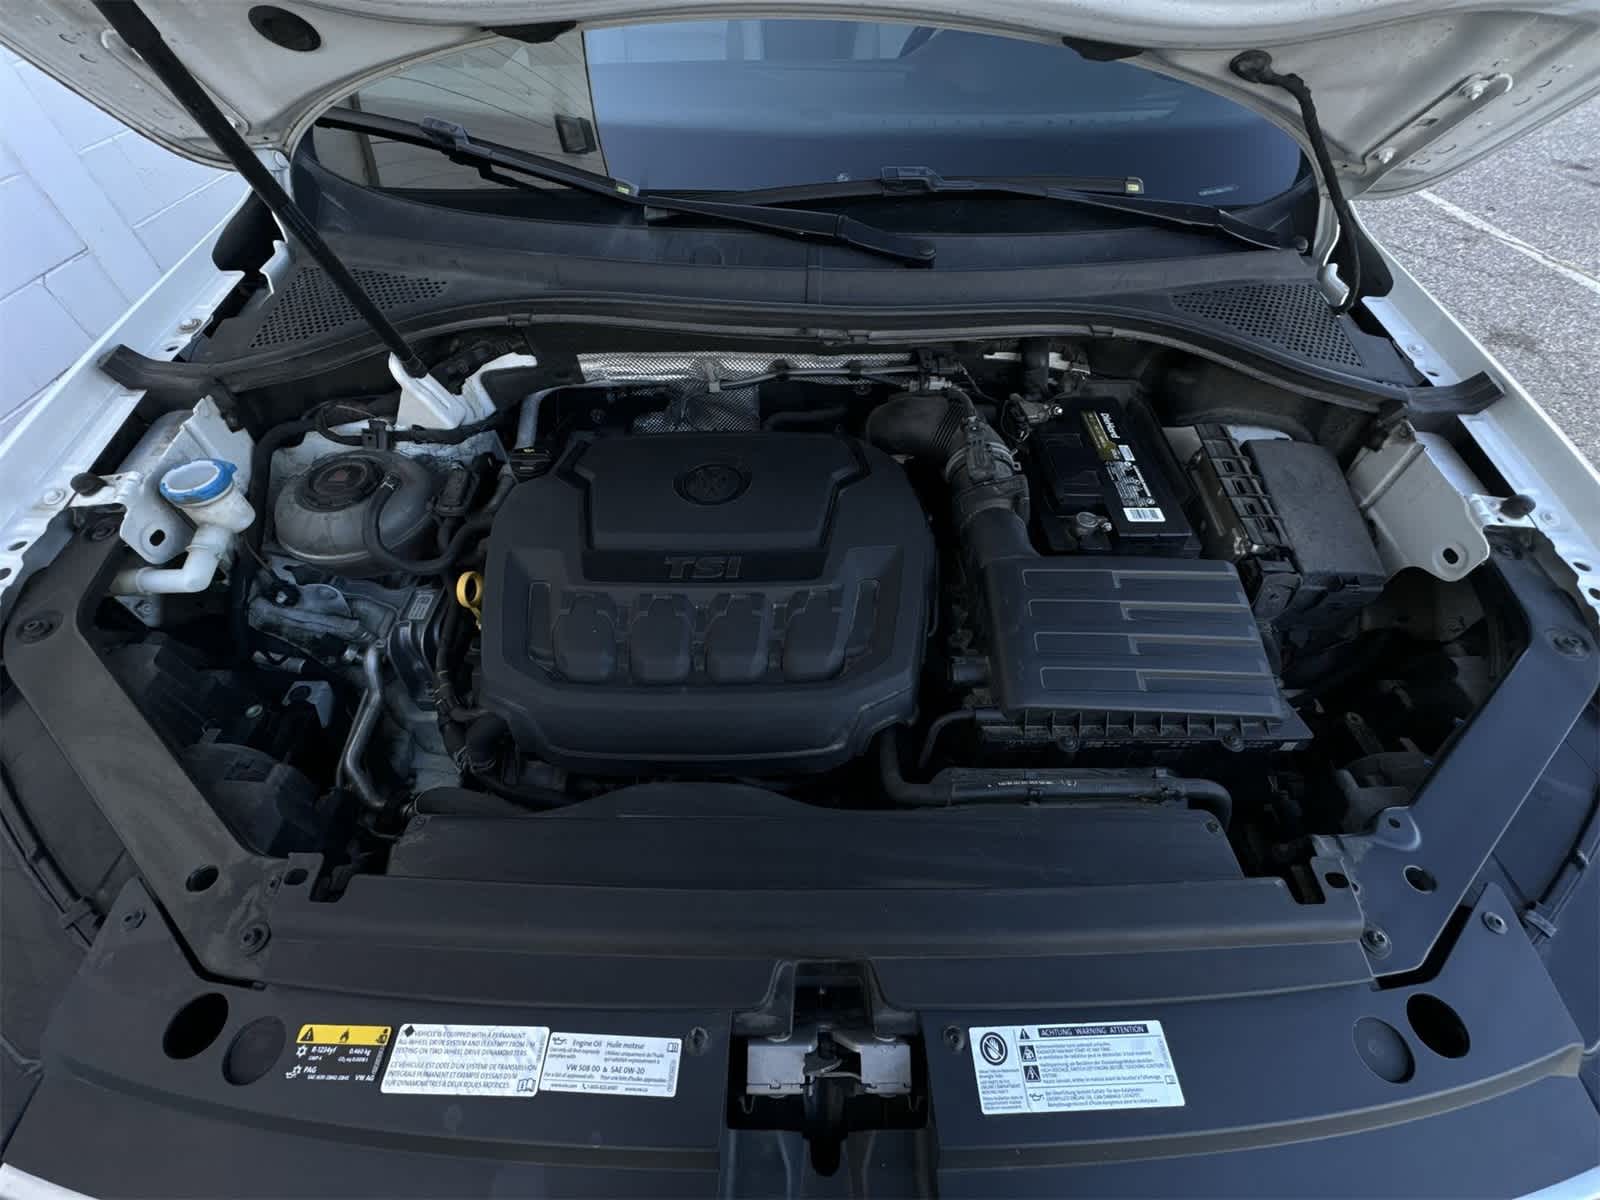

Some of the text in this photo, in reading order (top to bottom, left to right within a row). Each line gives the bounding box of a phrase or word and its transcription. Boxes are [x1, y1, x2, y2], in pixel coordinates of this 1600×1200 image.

[664, 556, 743, 579] TSI
[1041, 1025, 1145, 1036] ACHTUNG WARNING ATTENTION
[572, 1038, 645, 1050] Engine Oil Huile moteur
